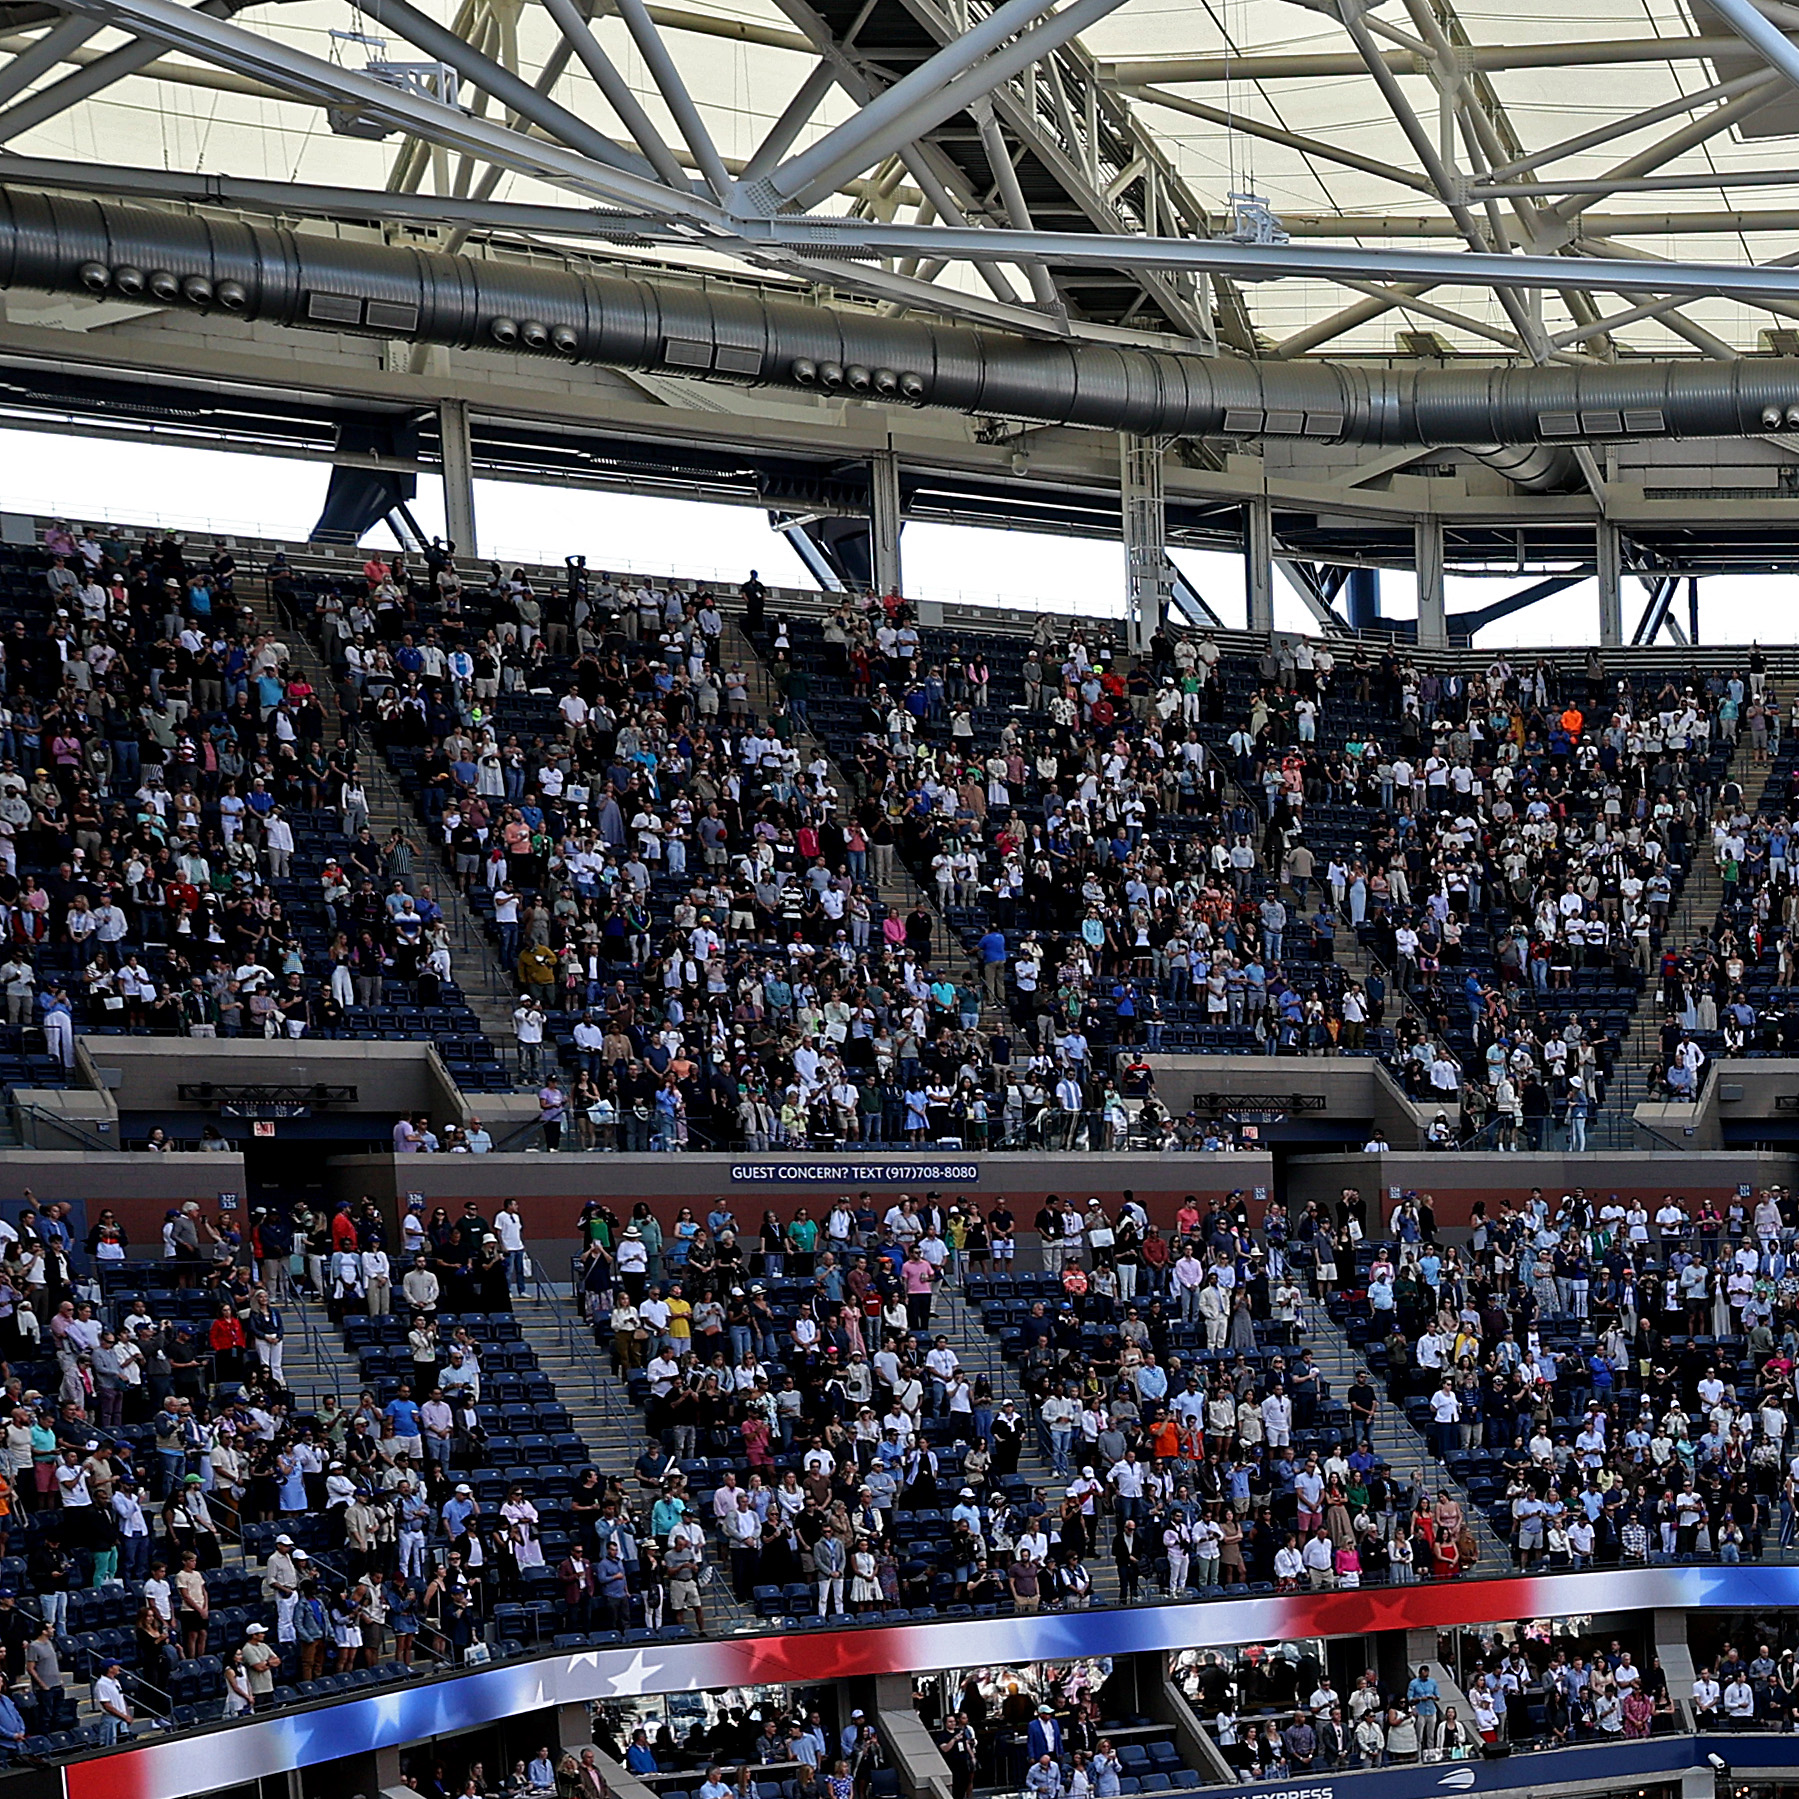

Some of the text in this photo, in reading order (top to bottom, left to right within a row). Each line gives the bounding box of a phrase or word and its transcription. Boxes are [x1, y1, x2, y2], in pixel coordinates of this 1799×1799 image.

[732, 1166, 978, 1180] GUEST CONCERN? TEXT (917)708-8080
